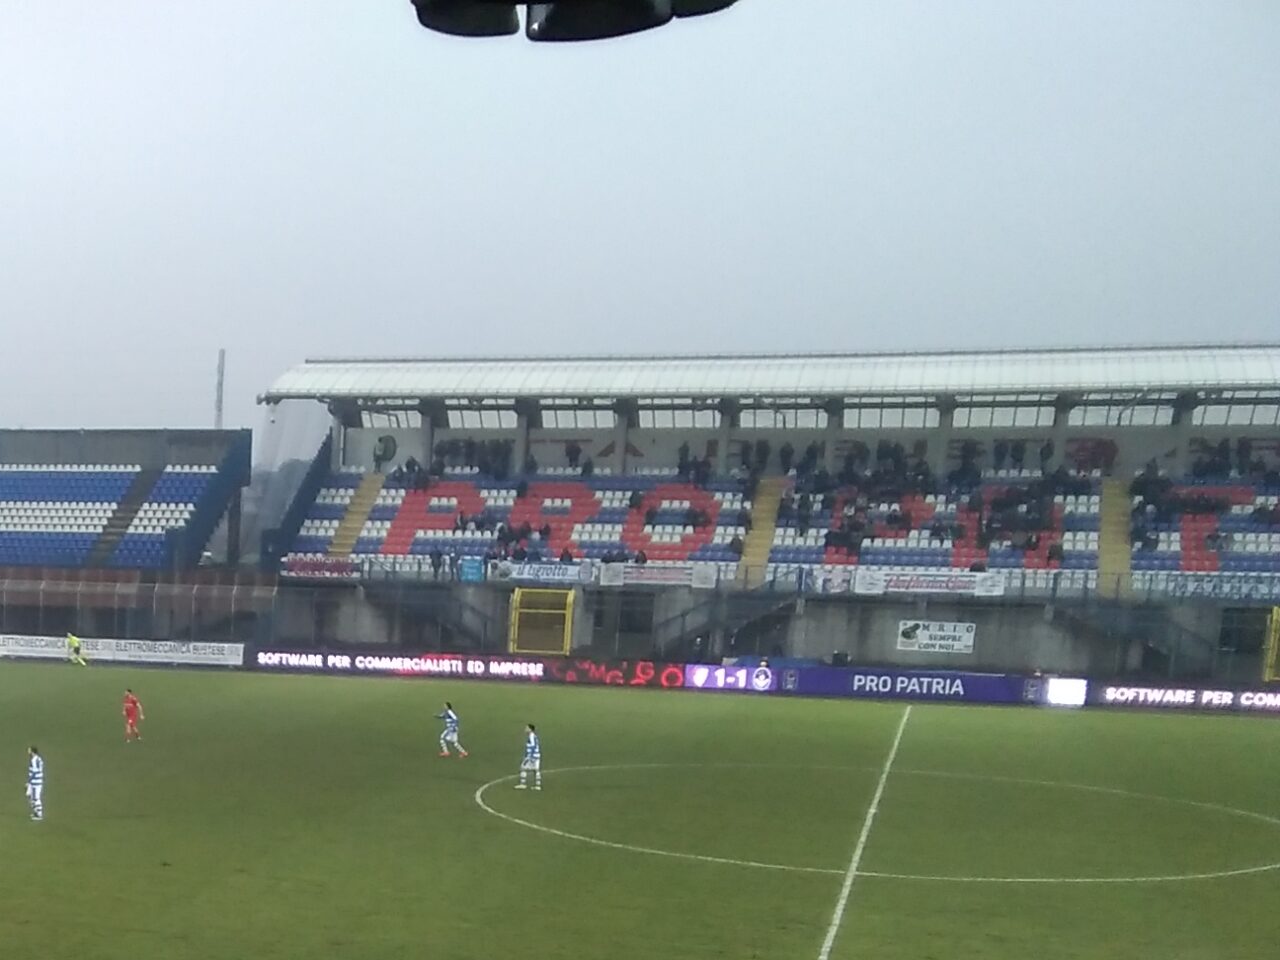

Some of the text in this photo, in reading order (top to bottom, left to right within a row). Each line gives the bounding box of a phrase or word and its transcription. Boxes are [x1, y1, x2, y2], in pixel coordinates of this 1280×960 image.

[257, 652, 323, 667] SOFTWARE
[327, 655, 351, 669] PER
[355, 656, 463, 674] COMMERCIALISTI
[466, 660, 485, 674] ED
[489, 661, 544, 676] IMPRESE
[853, 674, 965, 696] PRO PATRIA
[1105, 687, 1196, 704] SOFTWARE
[1201, 690, 1234, 705] PER
